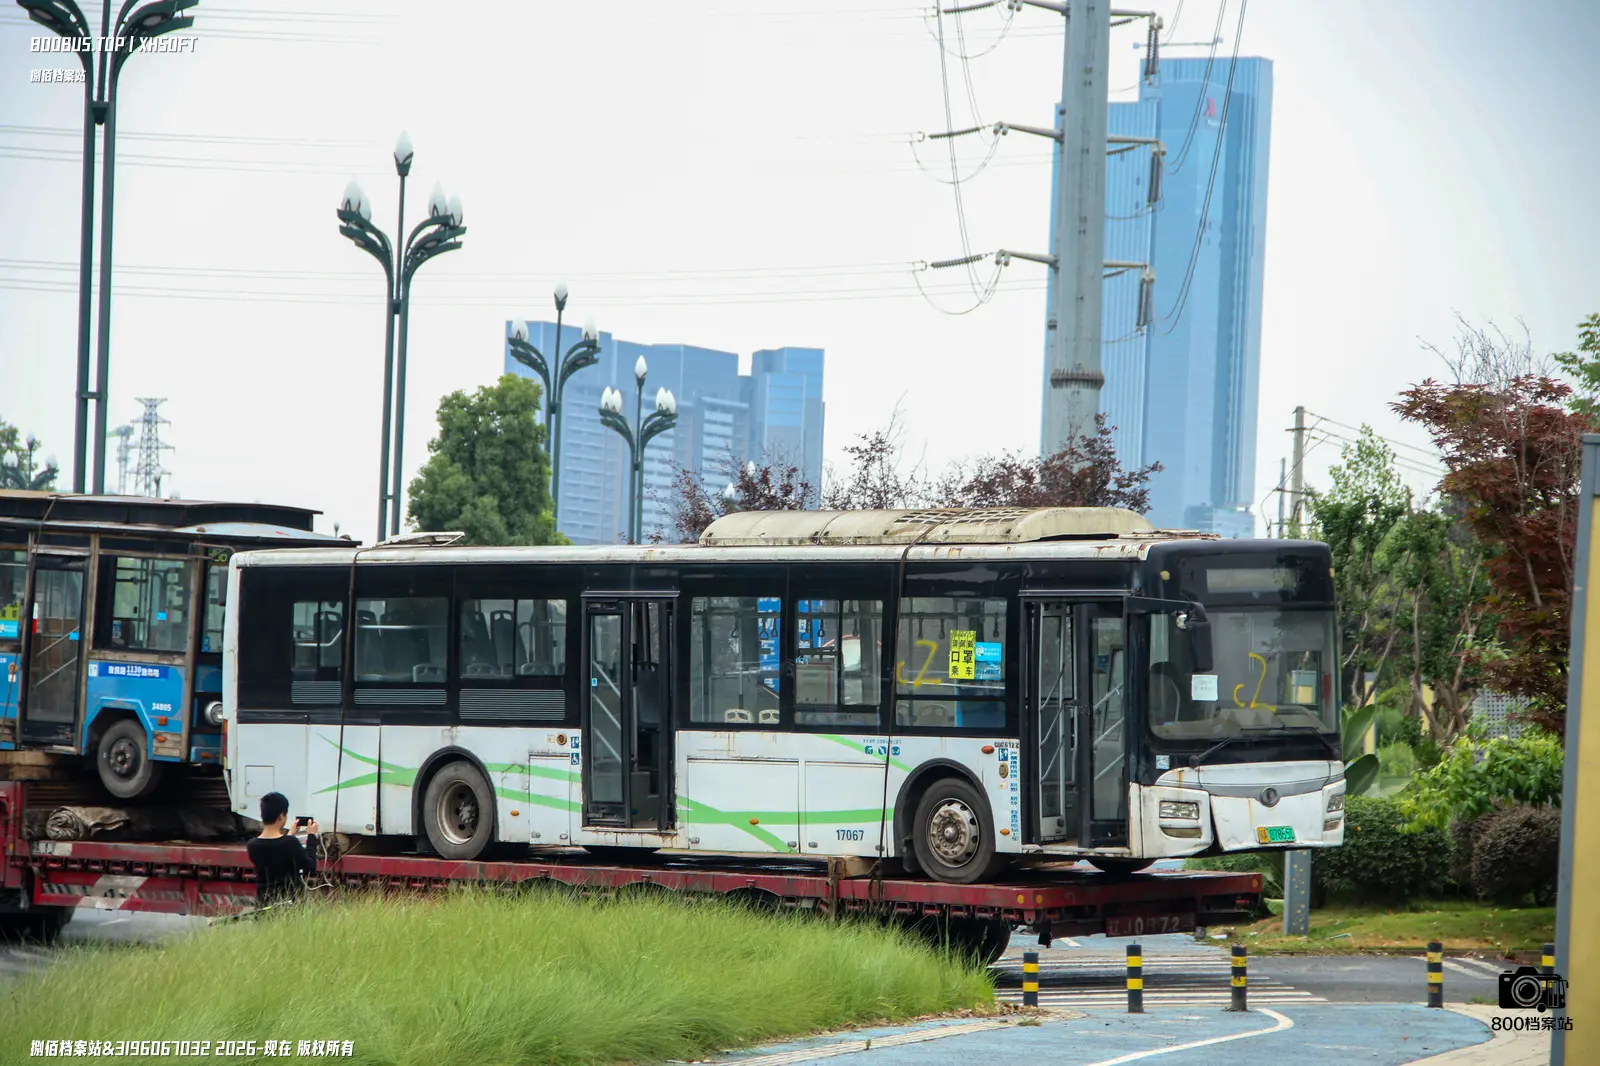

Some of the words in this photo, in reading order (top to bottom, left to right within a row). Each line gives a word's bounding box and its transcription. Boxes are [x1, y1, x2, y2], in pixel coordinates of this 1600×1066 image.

[126, 665, 142, 674] 1130
[151, 702, 172, 712] 34805
[836, 829, 864, 841] 17067
